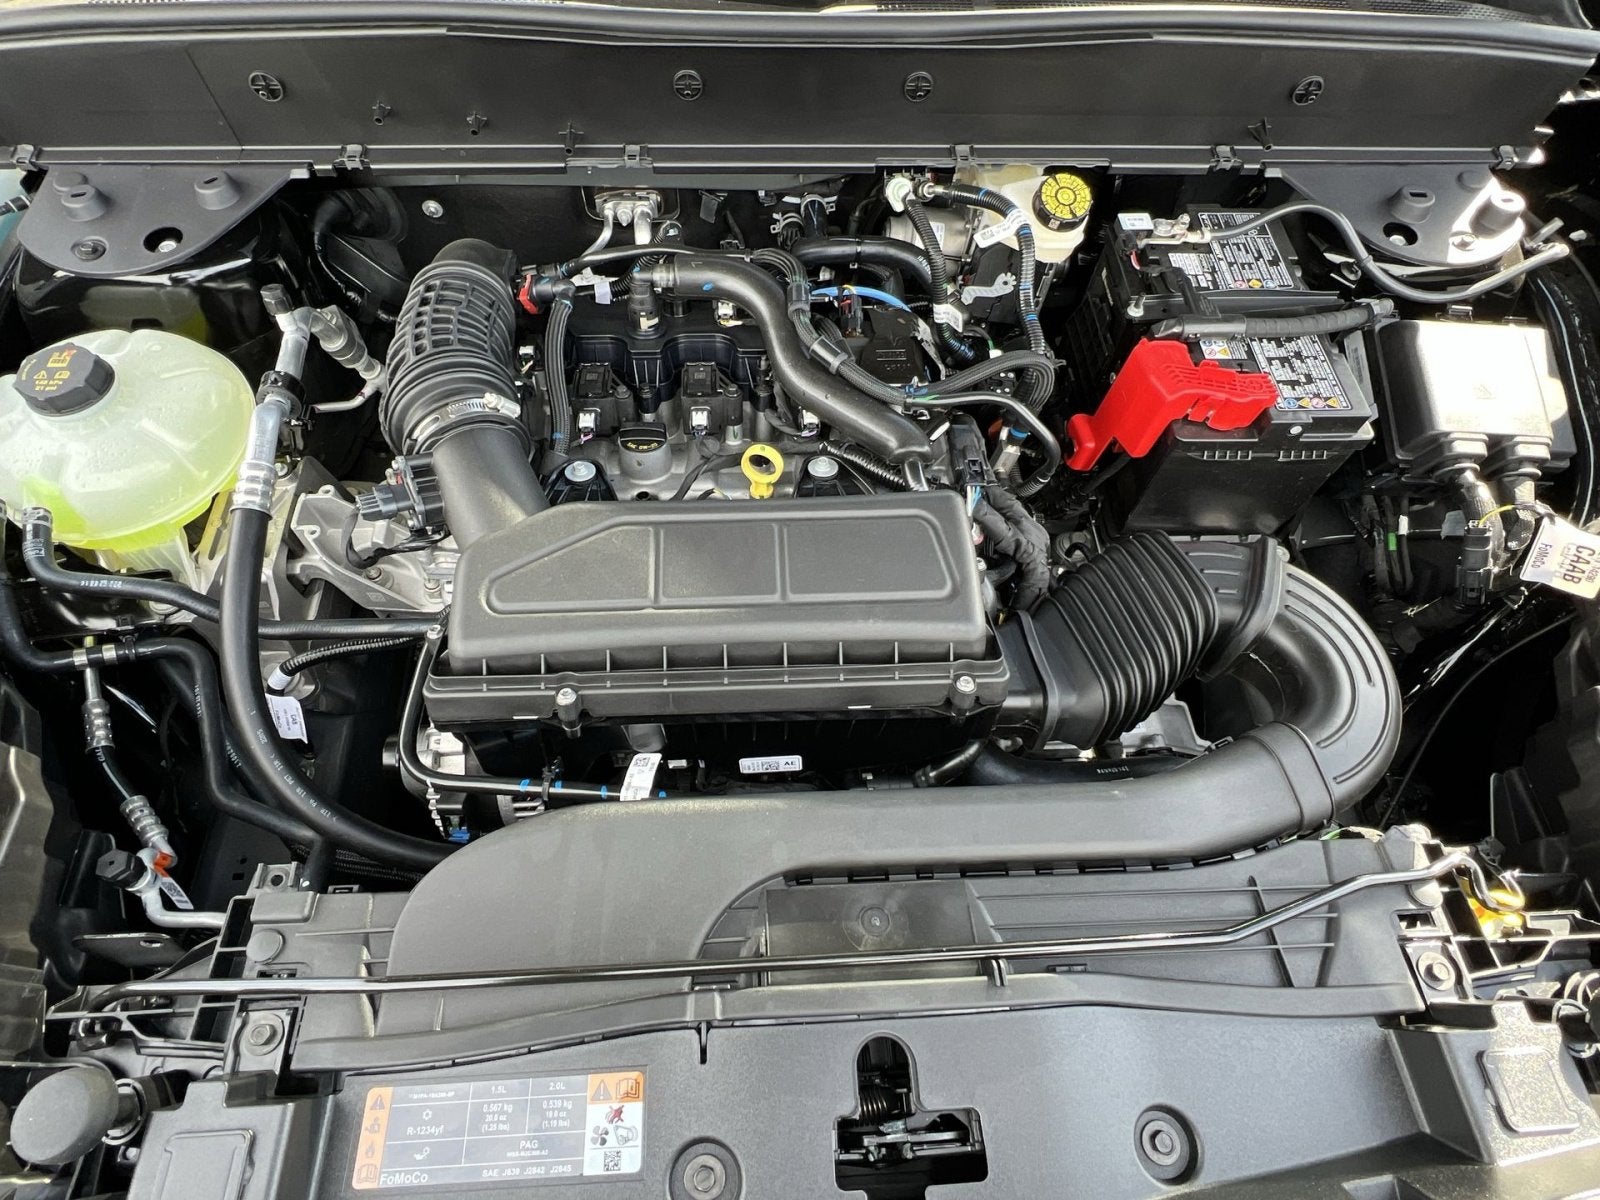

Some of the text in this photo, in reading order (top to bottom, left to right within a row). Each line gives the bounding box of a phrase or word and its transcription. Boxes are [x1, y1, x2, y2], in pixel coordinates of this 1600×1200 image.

[1562, 545, 1596, 584] CAAB
[490, 1081, 566, 1094] 1.5L 2.0L
[482, 1102, 513, 1114] 0.567 kg
[563, 1099, 573, 1110] kg
[406, 1125, 445, 1136] R-1234yf
[519, 1139, 539, 1149] PAG
[379, 1171, 429, 1185] FoMoCo
[482, 1168, 499, 1177] SAE
